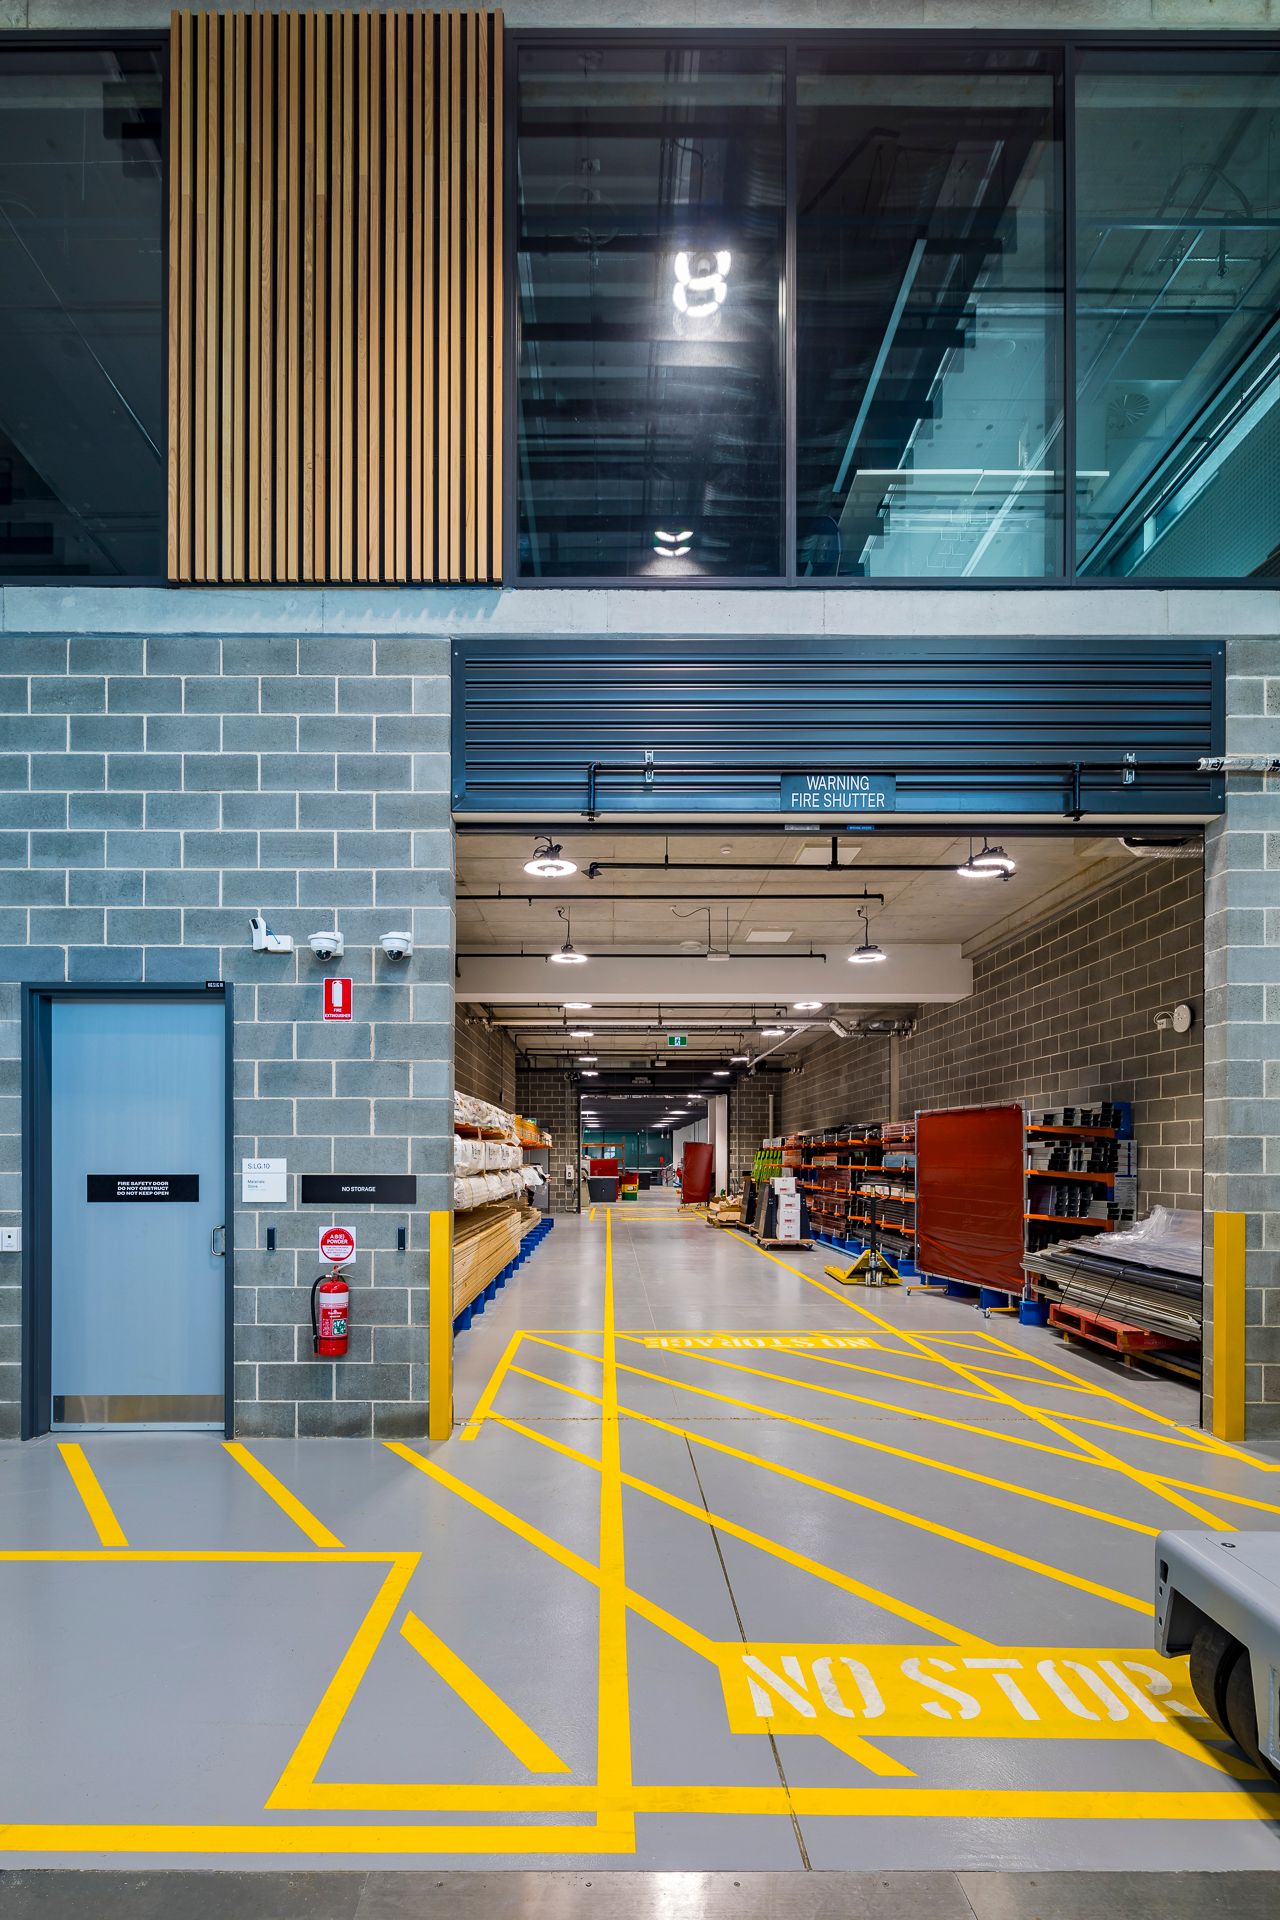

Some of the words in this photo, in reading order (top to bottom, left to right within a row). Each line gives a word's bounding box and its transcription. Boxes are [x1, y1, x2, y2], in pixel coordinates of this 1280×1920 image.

[806, 775, 870, 791] WARNING
[791, 793, 820, 808] FIRE
[823, 793, 885, 808] SHUTTER
[647, 1337, 814, 1348] STORAGE
[821, 1338, 873, 1348] NO
[741, 1655, 887, 1719] NO
[901, 1656, 1214, 1723] STOR
